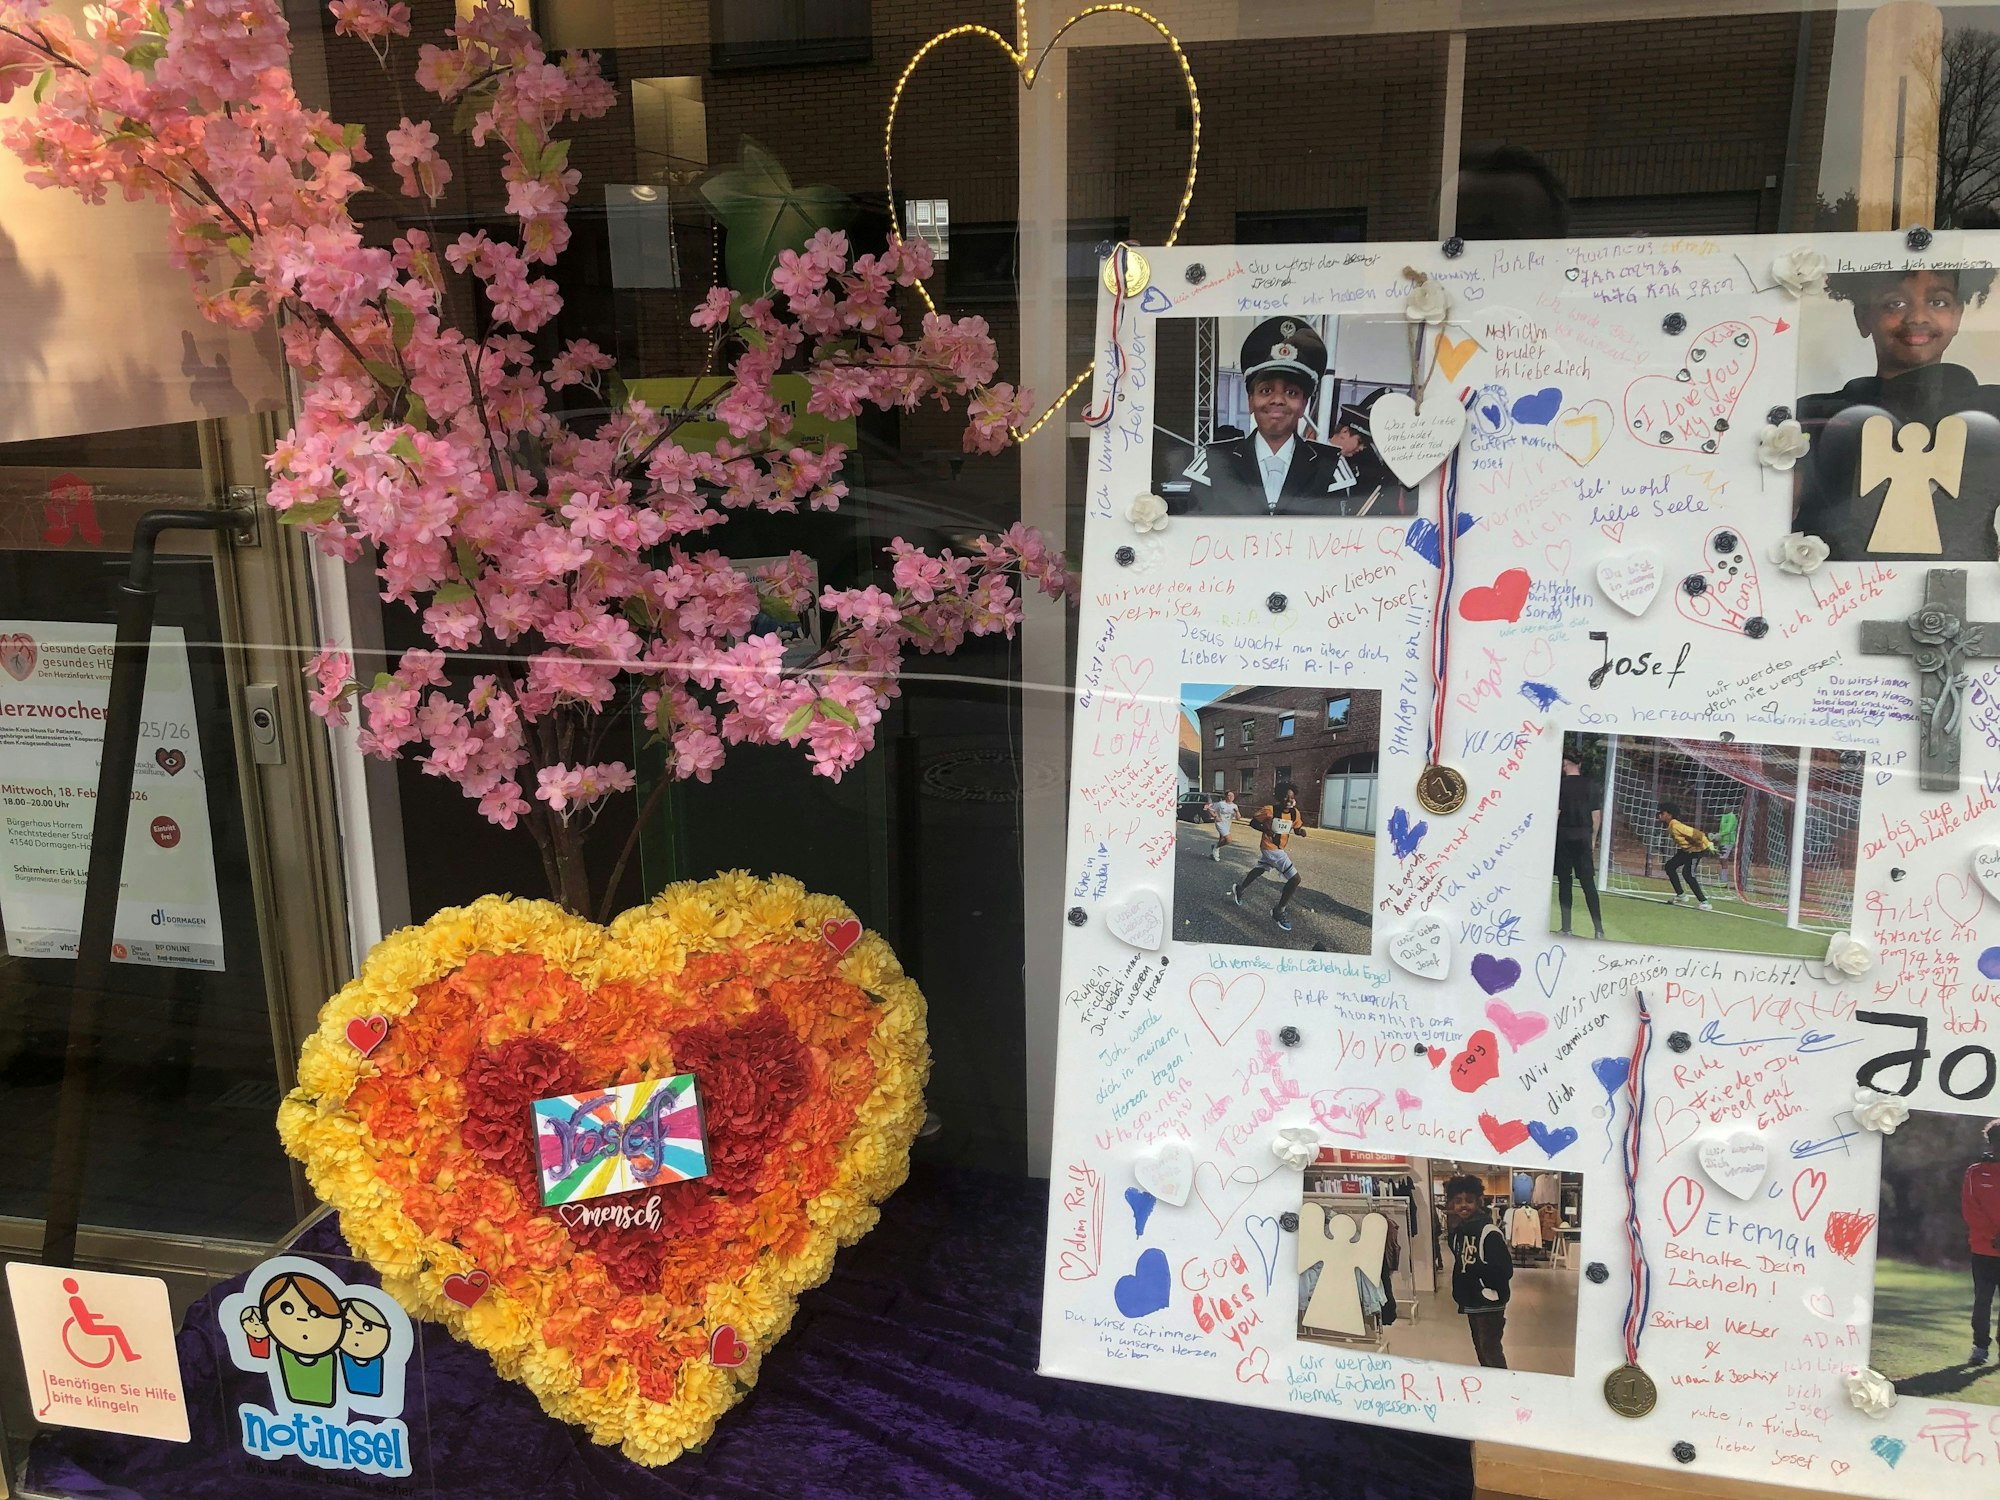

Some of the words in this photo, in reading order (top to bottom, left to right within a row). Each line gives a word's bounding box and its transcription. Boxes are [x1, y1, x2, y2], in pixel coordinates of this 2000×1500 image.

[1837, 258, 1857, 273] Ich
[1901, 258, 1928, 273] dich
[1930, 258, 1993, 271] vermissen
[1385, 420, 1406, 430] Was
[1410, 418, 1428, 429] die
[1635, 405, 1654, 432] I
[1391, 452, 1414, 462] nicht
[1409, 442, 1426, 451] der
[1428, 440, 1443, 449] Tod
[1621, 475, 1671, 495] wohl
[1477, 475, 1573, 532] vermissen
[1512, 511, 1572, 548] dich
[1304, 584, 1338, 608] Wir
[1779, 610, 1812, 639] ich
[1816, 571, 1852, 611] habe
[1828, 583, 1883, 627] disch
[1327, 600, 1368, 630] dich
[40, 643, 86, 655] Gesunde
[1181, 619, 1224, 647] Jesus
[1235, 635, 1281, 652] wacht
[1320, 641, 1349, 659] über
[1358, 644, 1389, 663] dich
[42, 658, 94, 669] gesundes
[1181, 650, 1227, 665] Lieber
[1588, 631, 1691, 690] Josef
[54, 672, 94, 680] Herzinfarkt
[1706, 681, 1731, 698] wir
[1736, 659, 1793, 687] werden
[1830, 676, 1844, 685] Du
[1848, 676, 1878, 685] wirst
[1881, 678, 1910, 688] immer
[1704, 696, 1738, 718] dich
[1744, 683, 1767, 703] nie
[1818, 687, 1827, 696] in
[1578, 705, 1618, 724] Sen
[1632, 705, 1735, 724] herzaman
[140, 722, 190, 740] 25/26
[2, 785, 56, 797] Mittwoch,
[59, 788, 75, 797] 18.
[1963, 784, 1998, 821] dich
[55, 800, 70, 808] Uhr
[7, 818, 51, 828] Bürgerhaus
[53, 820, 83, 829] Horrem
[8, 828, 70, 838] Knechtstedener
[153, 825, 177, 833] Eintritt
[160, 832, 173, 841] frei
[1863, 838, 1887, 860] Du
[14, 865, 58, 875] Schirmherr:
[60, 868, 73, 876] Erik
[15, 874, 60, 883] Bürgermeister
[61, 876, 72, 884] der
[166, 916, 206, 925] DORMAGEN
[59, 943, 74, 951] vhs
[166, 944, 191, 952] ONLINE
[1118, 952, 1142, 979] immer
[1209, 953, 1229, 969] Ich
[1277, 956, 1298, 973] dein
[1364, 965, 1391, 988] Engel
[1065, 976, 1096, 1009] Ruhe
[1092, 964, 1110, 983] in
[1553, 995, 1586, 1031] Wir
[1590, 960, 1668, 1004] vergessen
[1675, 958, 1722, 981] dich
[1733, 964, 1802, 985] nicht!
[1129, 1007, 1163, 1044] werde
[1519, 1062, 1549, 1091] Wir
[1554, 1013, 1610, 1061] vermissen
[1096, 1078, 1121, 1104] dich
[1121, 1068, 1134, 1080] in
[1137, 1026, 1179, 1066] meinem
[1673, 1055, 1725, 1090] Ruhe
[1112, 1089, 1148, 1121] Herzen
[1547, 1083, 1576, 1115] dich
[1064, 1159, 1096, 1212] Ralf
[583, 1196, 662, 1233] mensch
[1664, 1242, 1751, 1270] Behalte
[1756, 1255, 1806, 1275] Dein
[1668, 1268, 1757, 1298] Lächeln
[1065, 1310, 1086, 1322] Du
[1155, 1329, 1203, 1342] immer
[1650, 1311, 1710, 1331] Bärbel
[1725, 1317, 1780, 1339] Weber
[1100, 1331, 1113, 1343] in
[1172, 1346, 1217, 1358] Herzen
[1300, 1354, 1324, 1370] Wir
[1335, 1354, 1393, 1371] werden
[49, 1374, 116, 1394] Benötigen
[120, 1382, 142, 1397] Sie
[145, 1386, 177, 1402] Hilfe
[1287, 1366, 1317, 1386] dein
[53, 1391, 83, 1406] bitte
[86, 1396, 139, 1415] klingeln
[1738, 1409, 1754, 1428] in
[244, 1412, 403, 1469] notinsel
